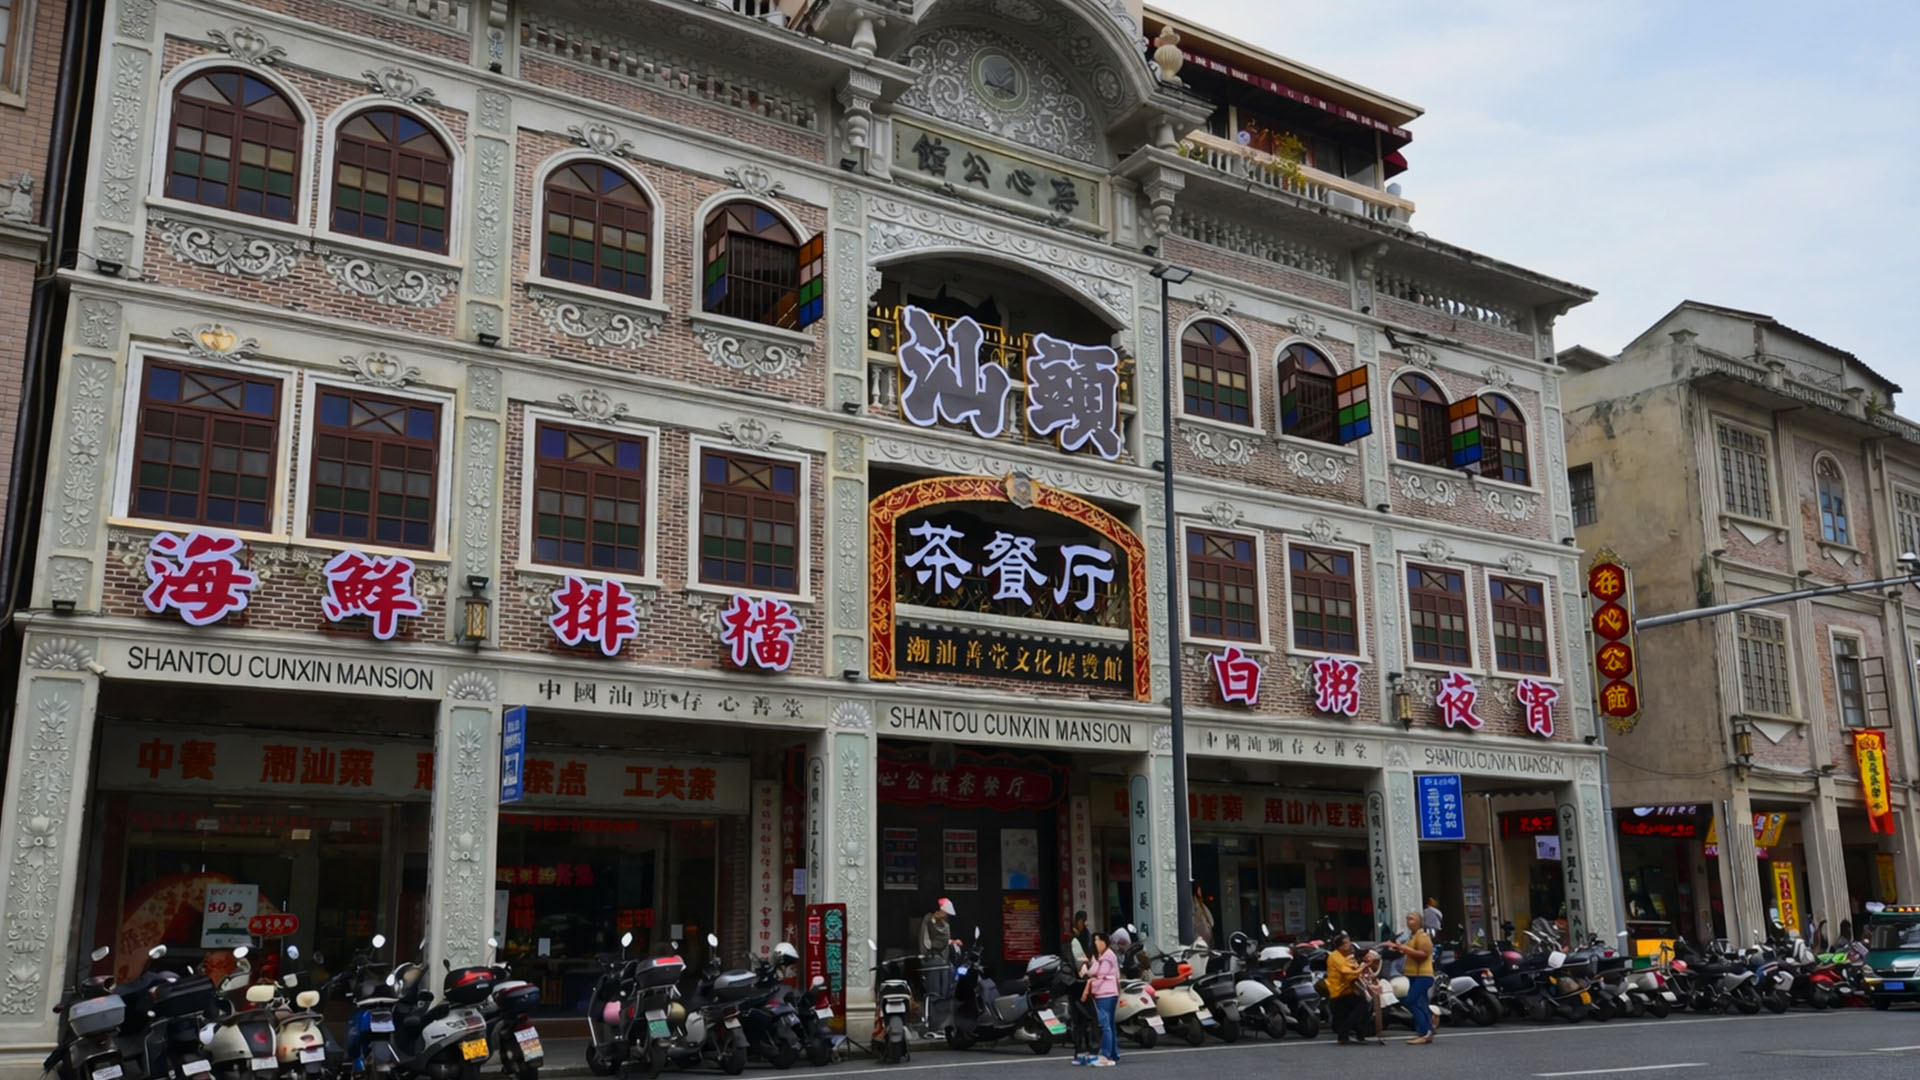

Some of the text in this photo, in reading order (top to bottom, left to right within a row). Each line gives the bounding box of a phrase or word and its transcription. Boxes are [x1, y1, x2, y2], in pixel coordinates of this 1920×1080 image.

[904, 519, 1115, 612] 茶餐厅
[127, 645, 434, 692] SHANTOU CUNXIN MANSION
[889, 706, 1133, 745] SHANTOU CUNXIN MANSION
